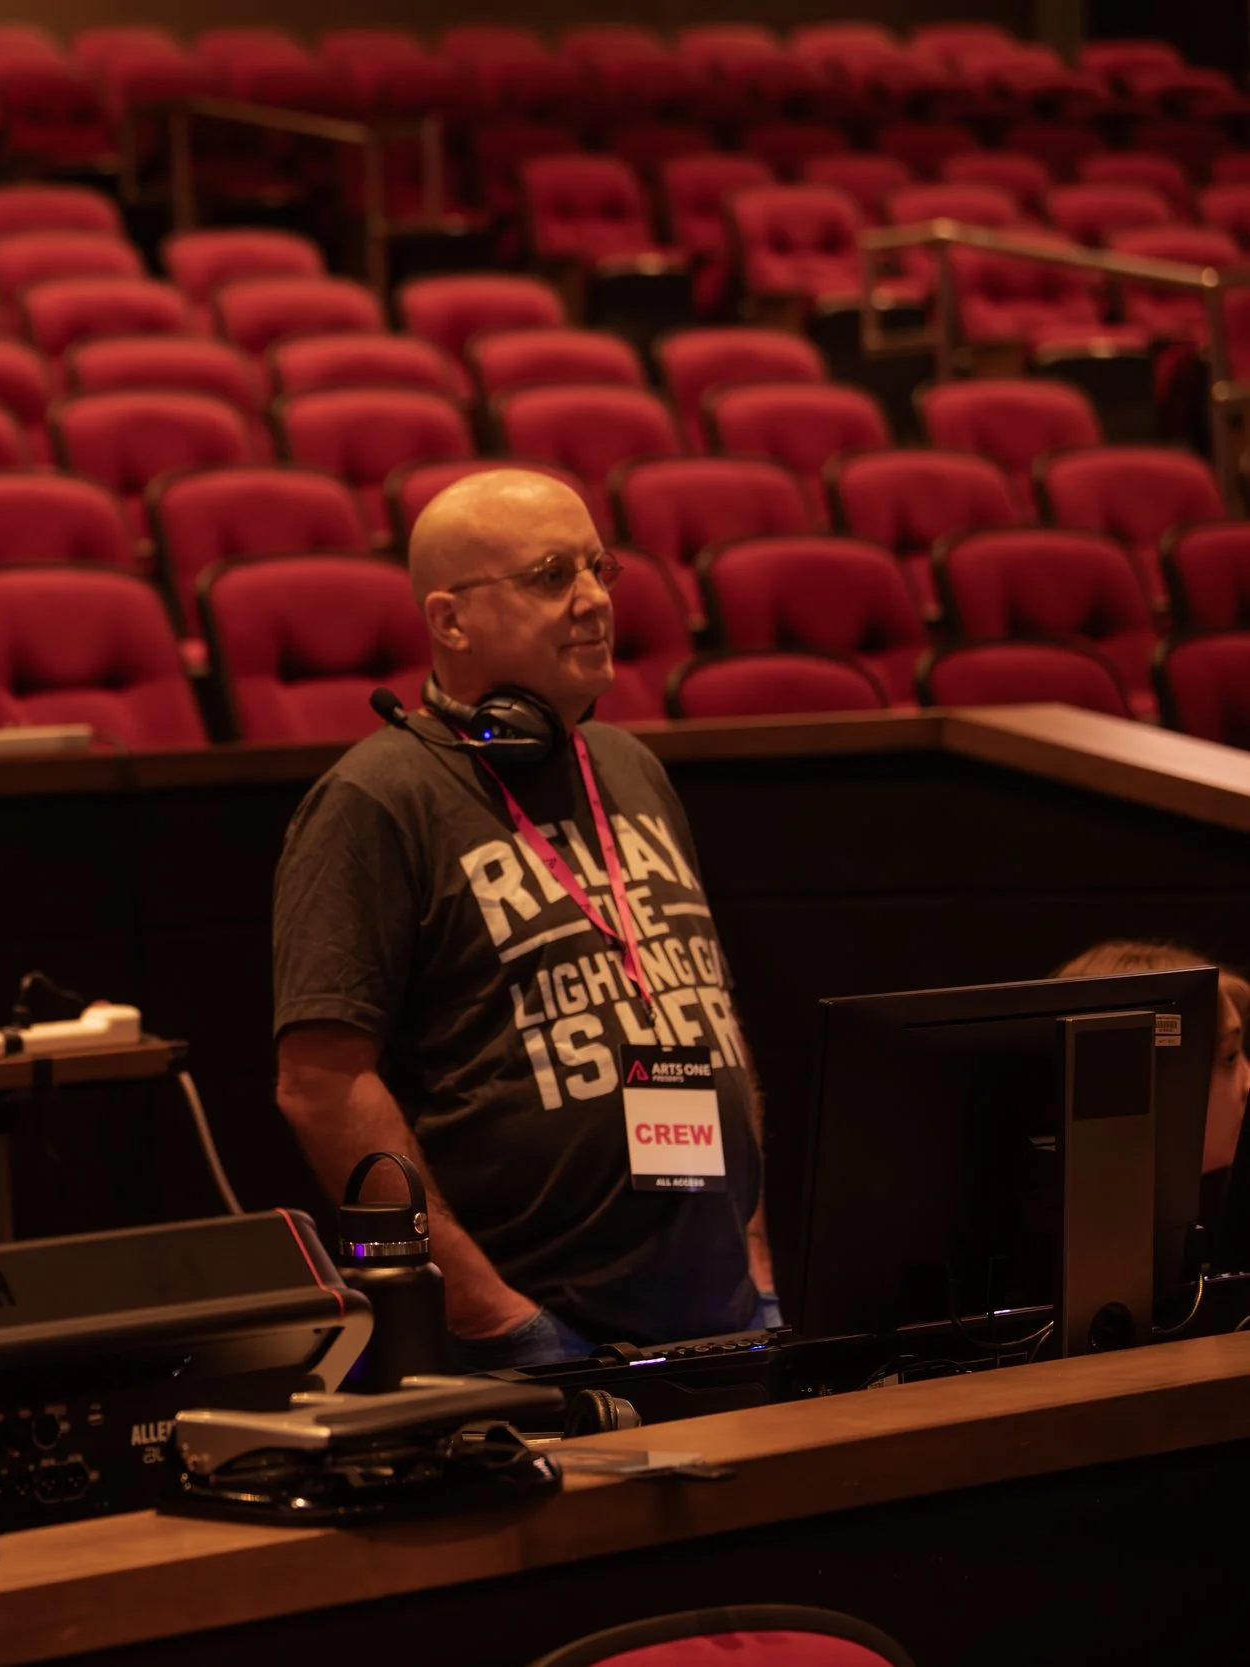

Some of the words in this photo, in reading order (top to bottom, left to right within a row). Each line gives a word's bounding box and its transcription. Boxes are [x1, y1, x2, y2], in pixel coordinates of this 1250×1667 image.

[510, 937, 697, 1030] LIGHTNG
[522, 1012, 619, 1111] IS
[652, 1062, 683, 1076] ARTS
[684, 1063, 712, 1077] ONE
[635, 1122, 714, 1146] CREW
[655, 1178, 672, 1187] ALL
